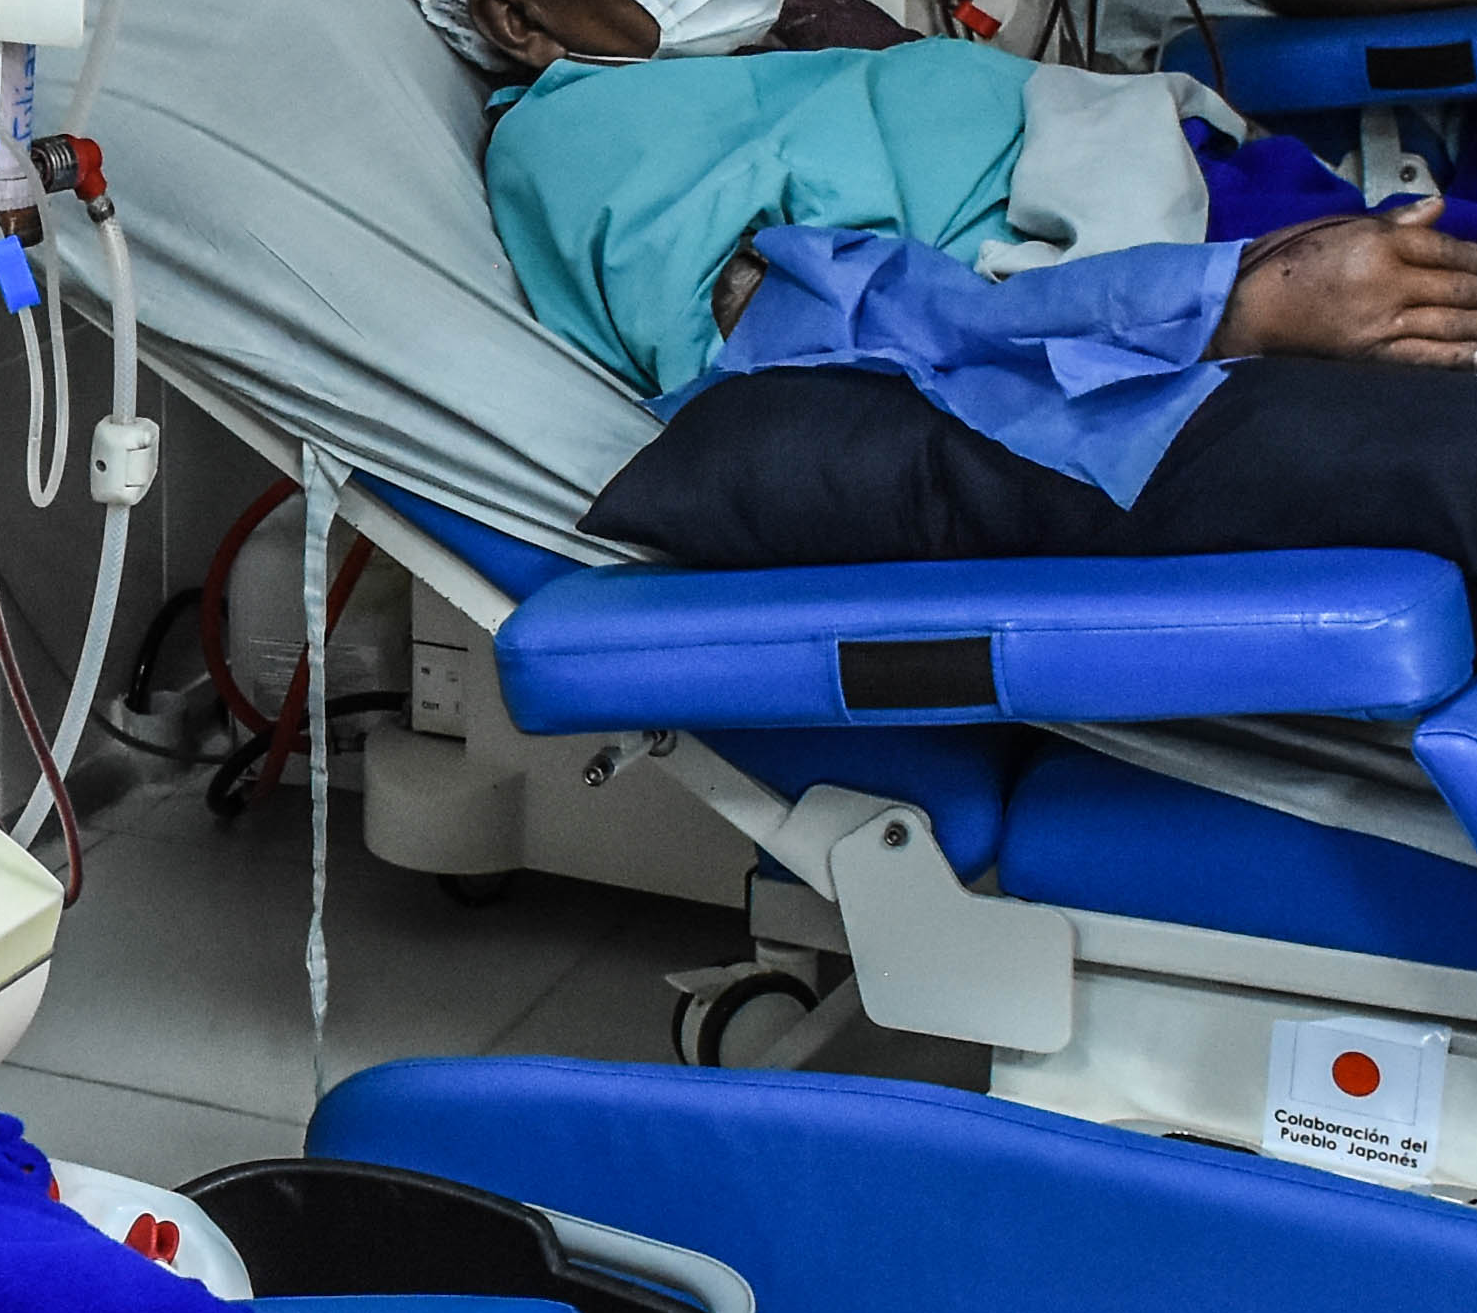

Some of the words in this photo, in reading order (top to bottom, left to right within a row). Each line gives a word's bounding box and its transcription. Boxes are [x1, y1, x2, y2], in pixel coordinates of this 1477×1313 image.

[1274, 1109, 1390, 1146] Colaboración
[1400, 1137, 1428, 1154] del
[1281, 1127, 1338, 1151] Pueblo
[1347, 1142, 1418, 1169] Japonés
